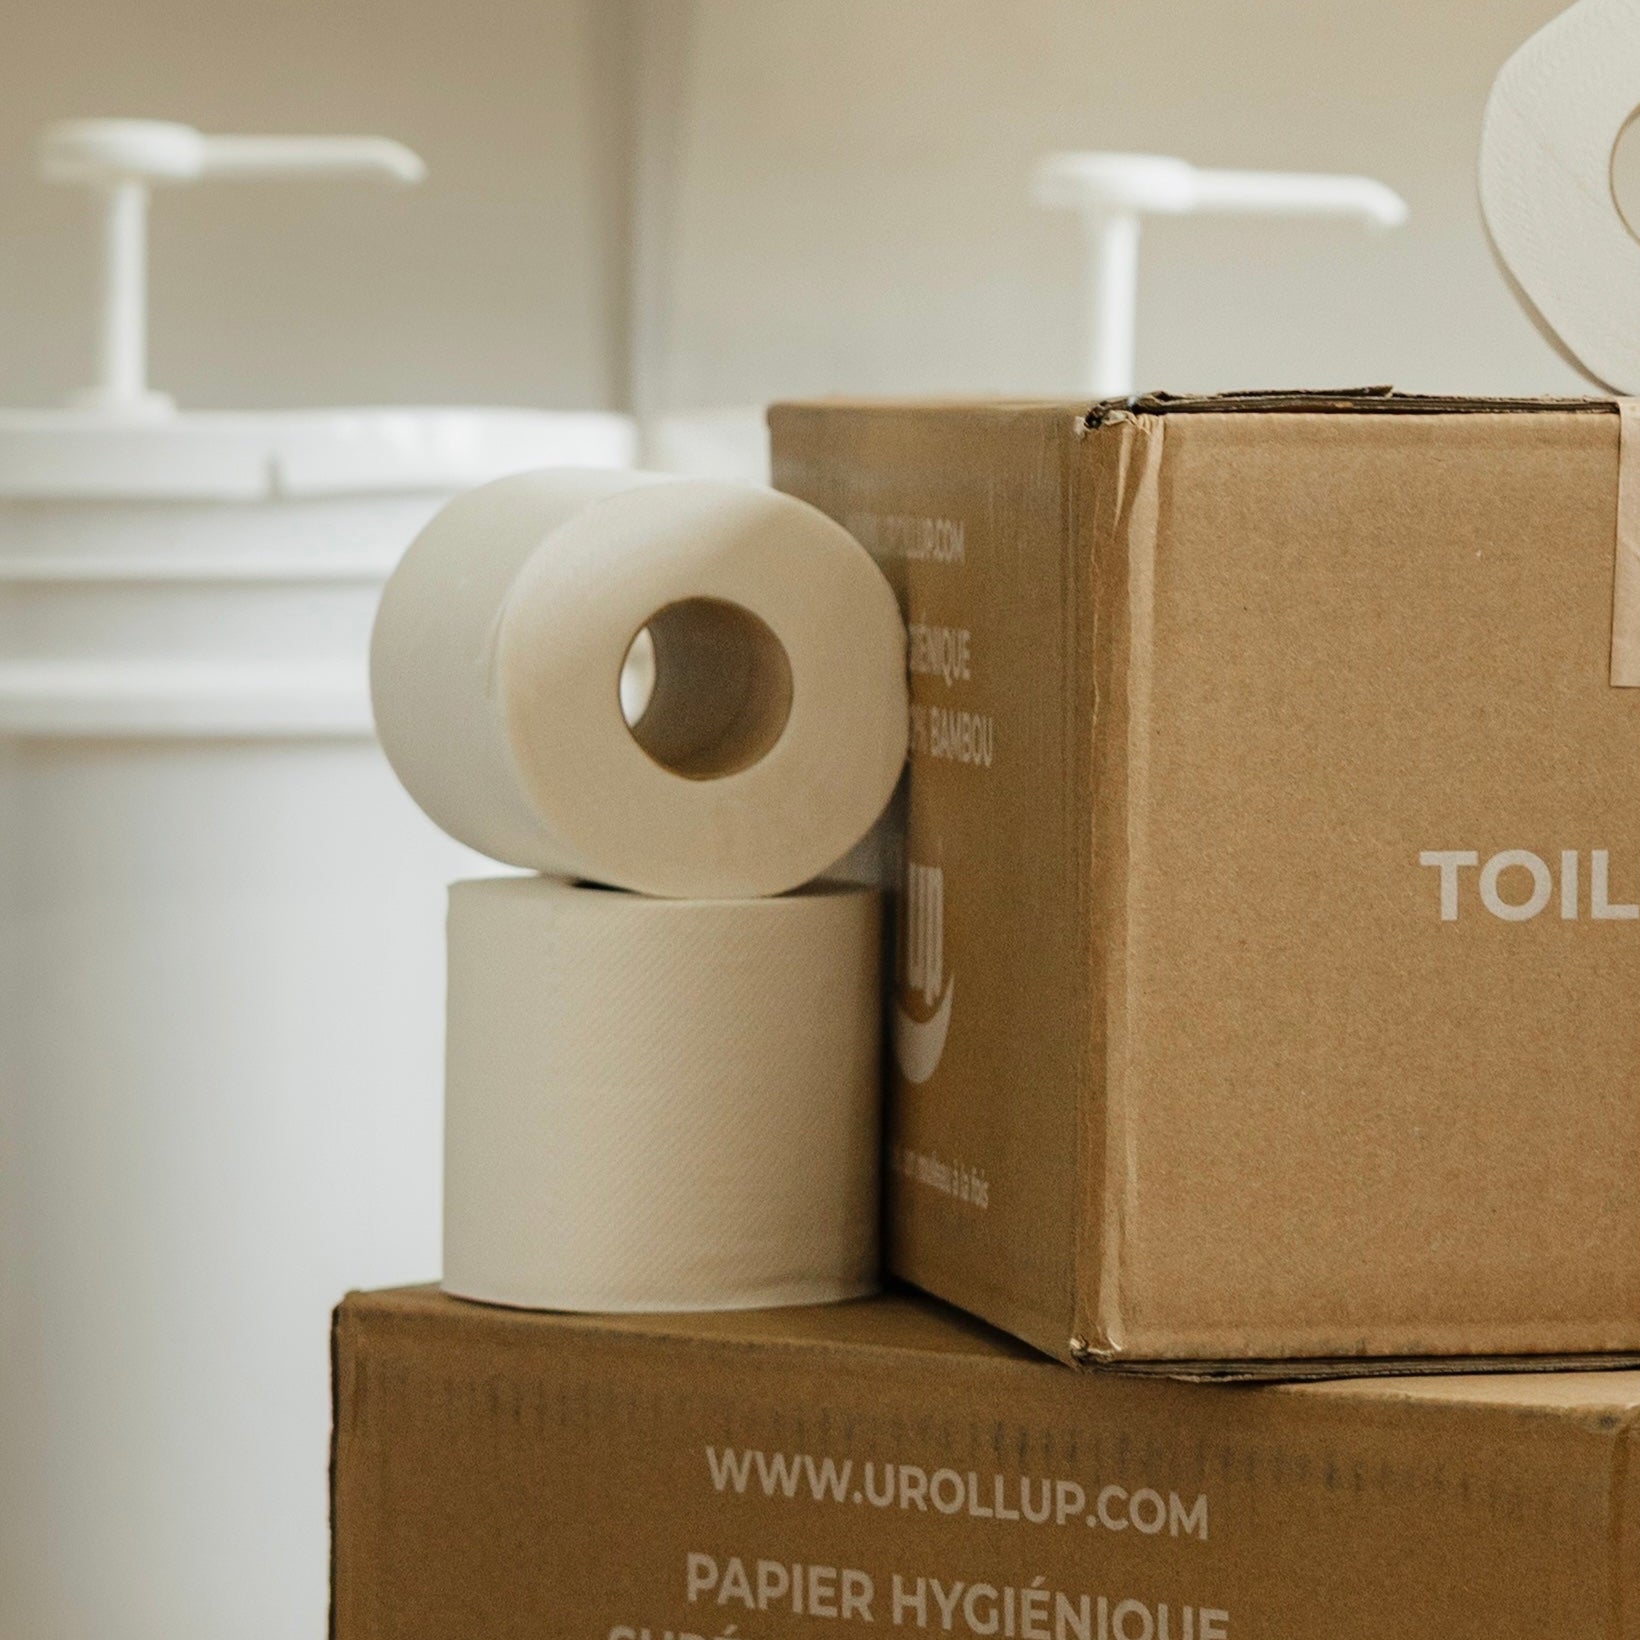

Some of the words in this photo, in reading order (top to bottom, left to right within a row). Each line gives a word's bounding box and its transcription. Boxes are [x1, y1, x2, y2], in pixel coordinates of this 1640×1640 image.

[931, 705, 993, 767] BAMBOU
[705, 1445, 1209, 1540] WWW.UROLLUP.COM
[686, 1552, 875, 1621] PAPIER
